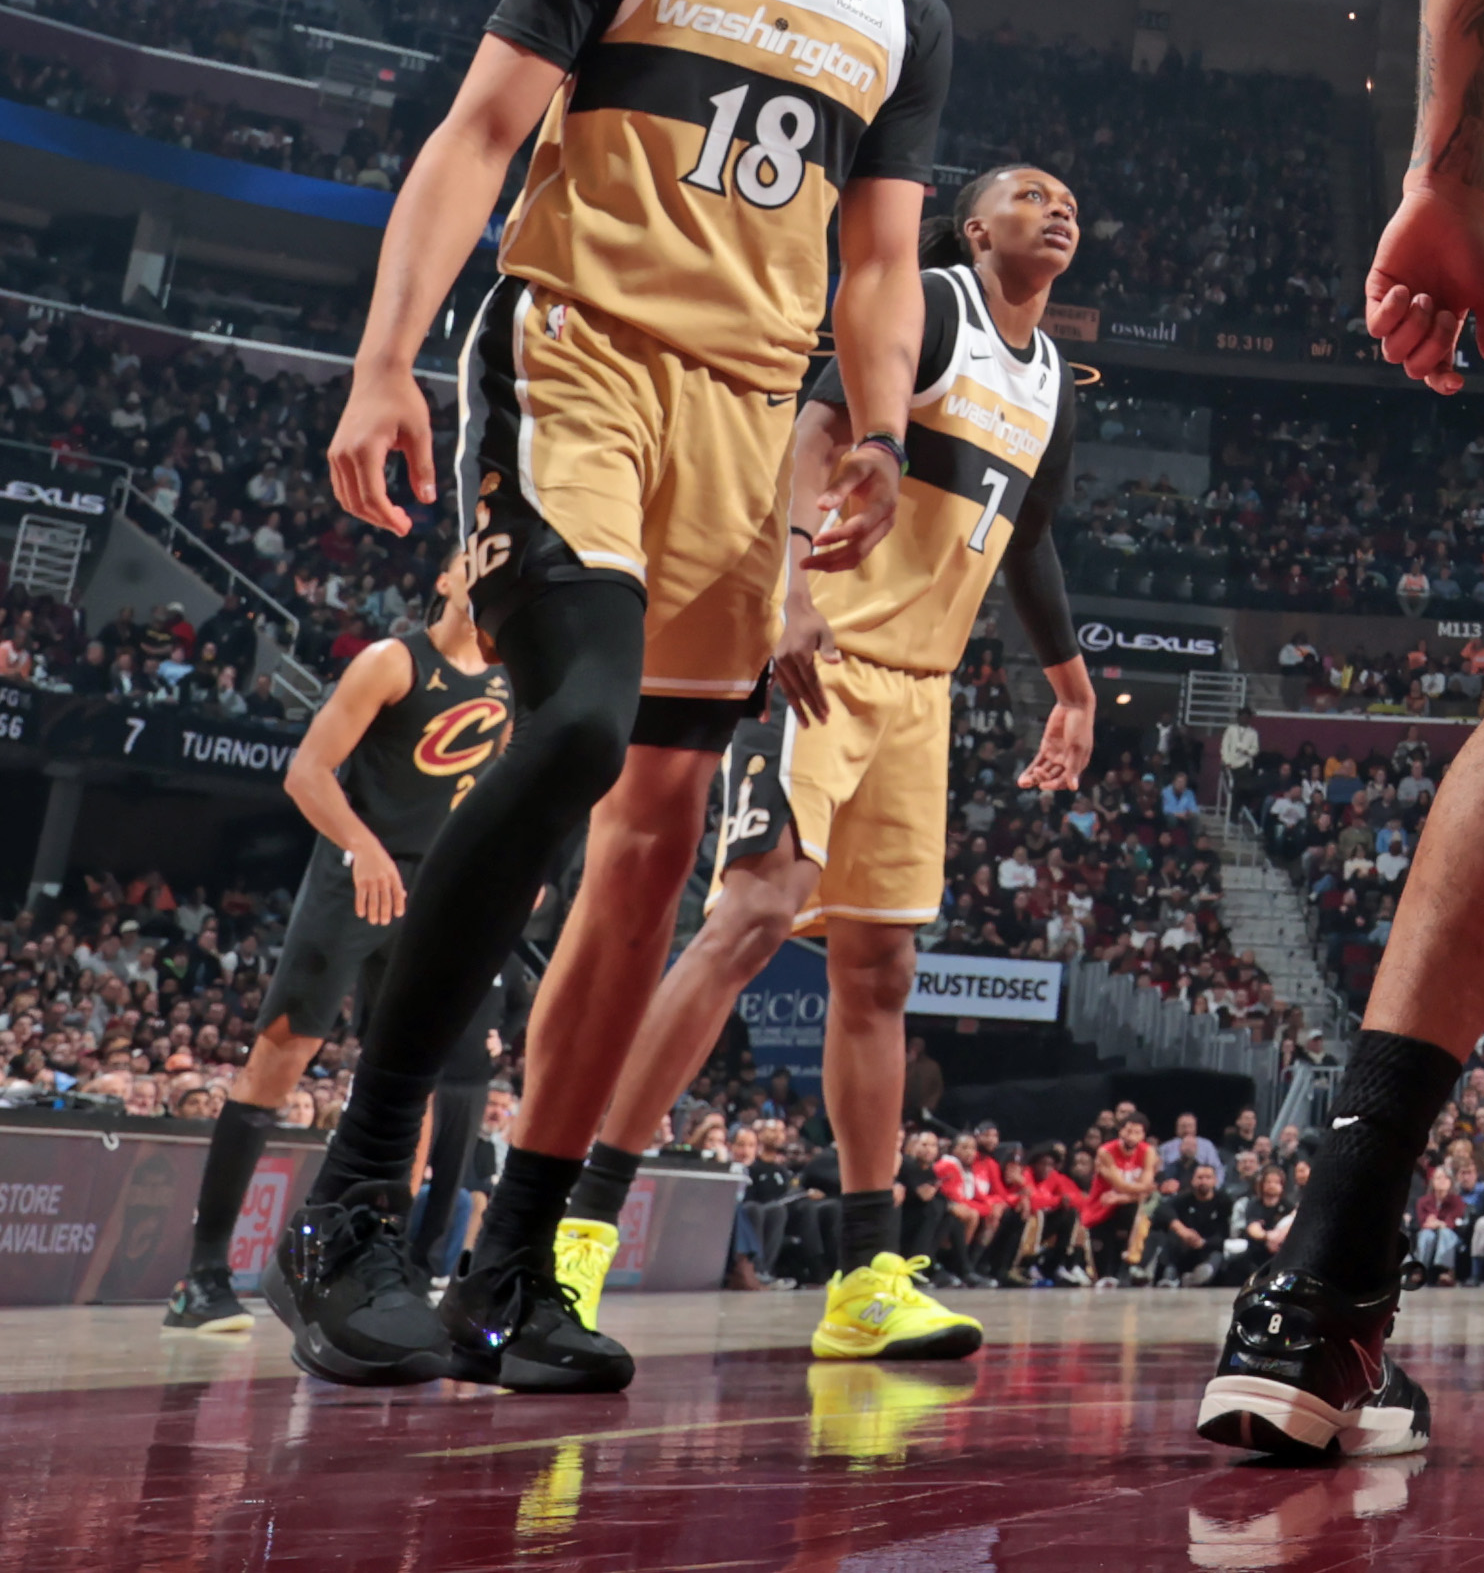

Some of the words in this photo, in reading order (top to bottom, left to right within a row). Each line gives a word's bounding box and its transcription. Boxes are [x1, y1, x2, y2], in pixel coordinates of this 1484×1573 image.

[678, 83, 816, 211] 18
[1111, 320, 1178, 343] oswald
[1437, 621, 1483, 639] M113
[1116, 631, 1217, 657] LEXUS
[123, 717, 146, 755] 7
[0, 1221, 97, 1254] AVALIERS
[1267, 1312, 1283, 1335] 8
